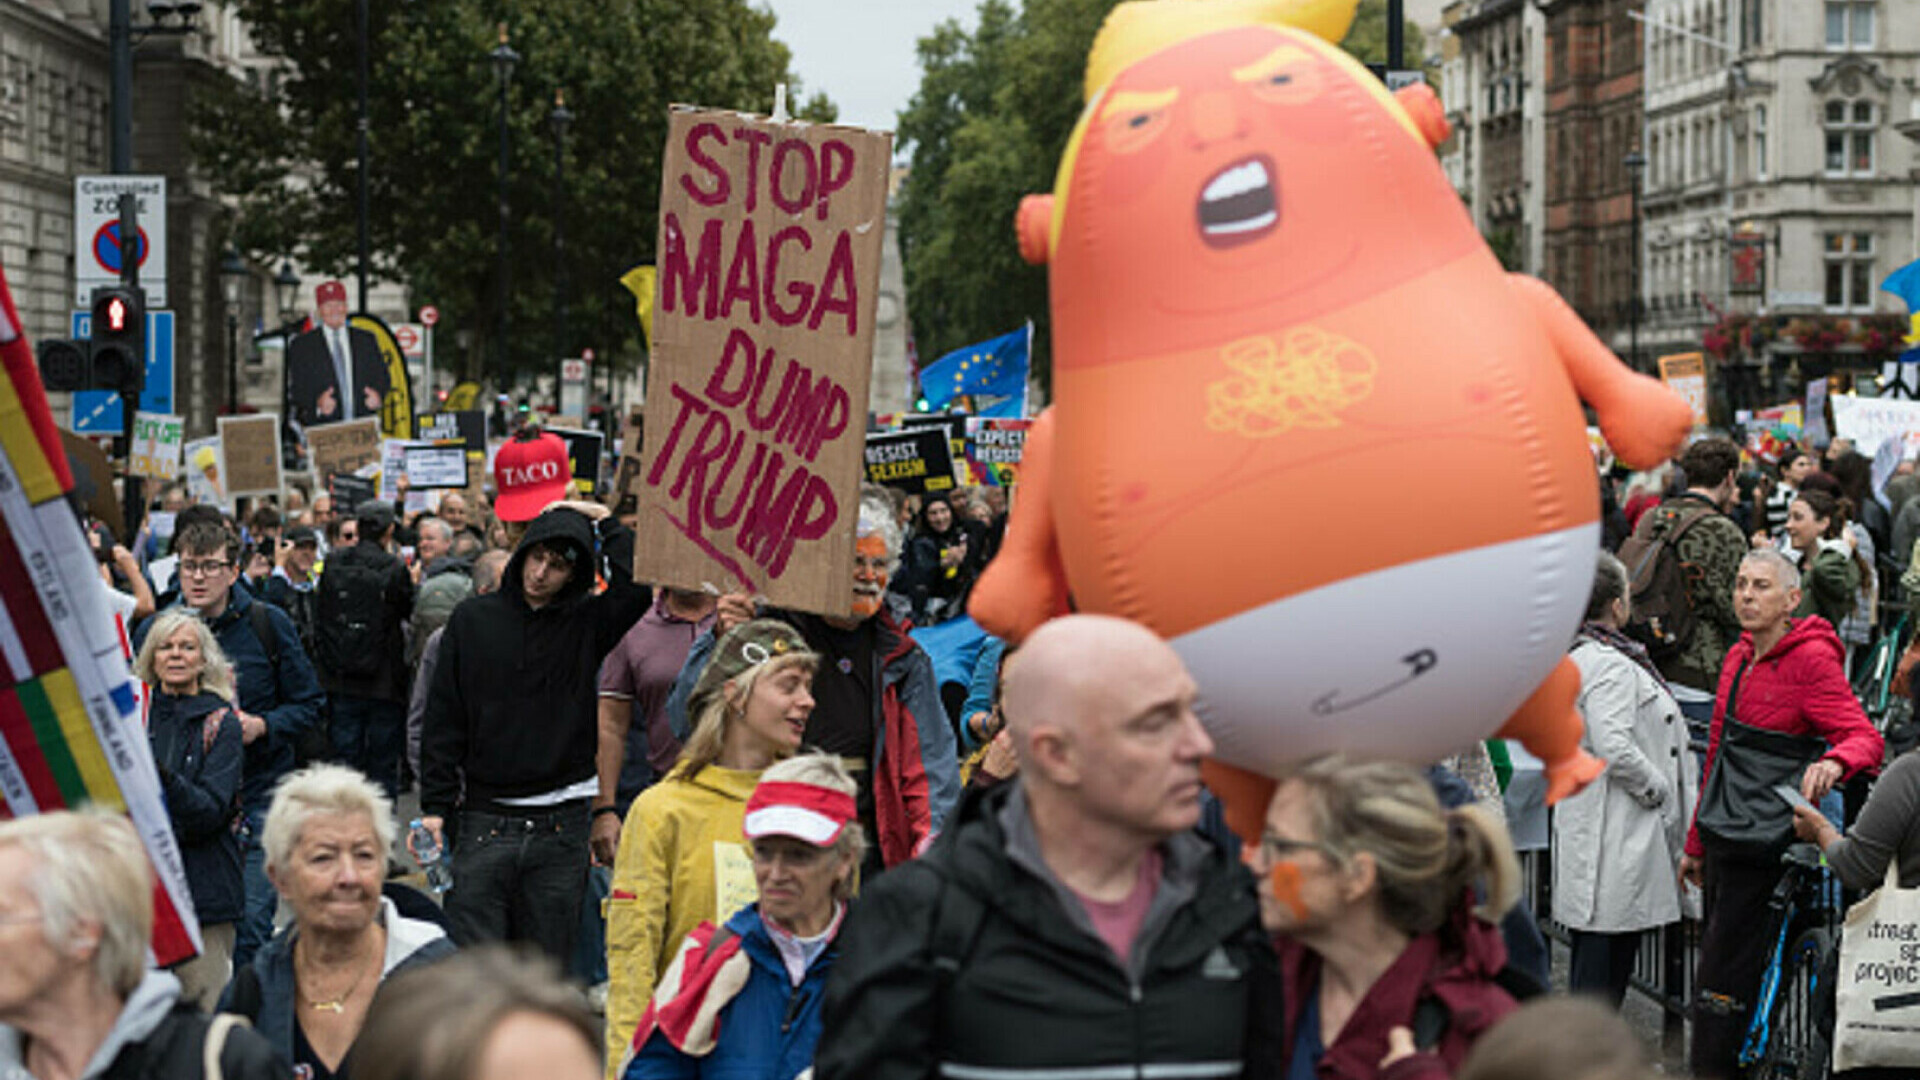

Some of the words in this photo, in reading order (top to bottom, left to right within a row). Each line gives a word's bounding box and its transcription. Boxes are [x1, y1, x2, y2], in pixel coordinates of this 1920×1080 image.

[93, 198, 149, 214] ZOE
[680, 122, 855, 221] STOP
[661, 211, 858, 337] MAGA
[704, 327, 851, 463] DUMP
[502, 460, 558, 486] TACO
[646, 382, 839, 579] TRUMP
[865, 441, 919, 463] RESIST
[868, 458, 928, 482] SEXISM
[30, 551, 69, 622] ESTLAND
